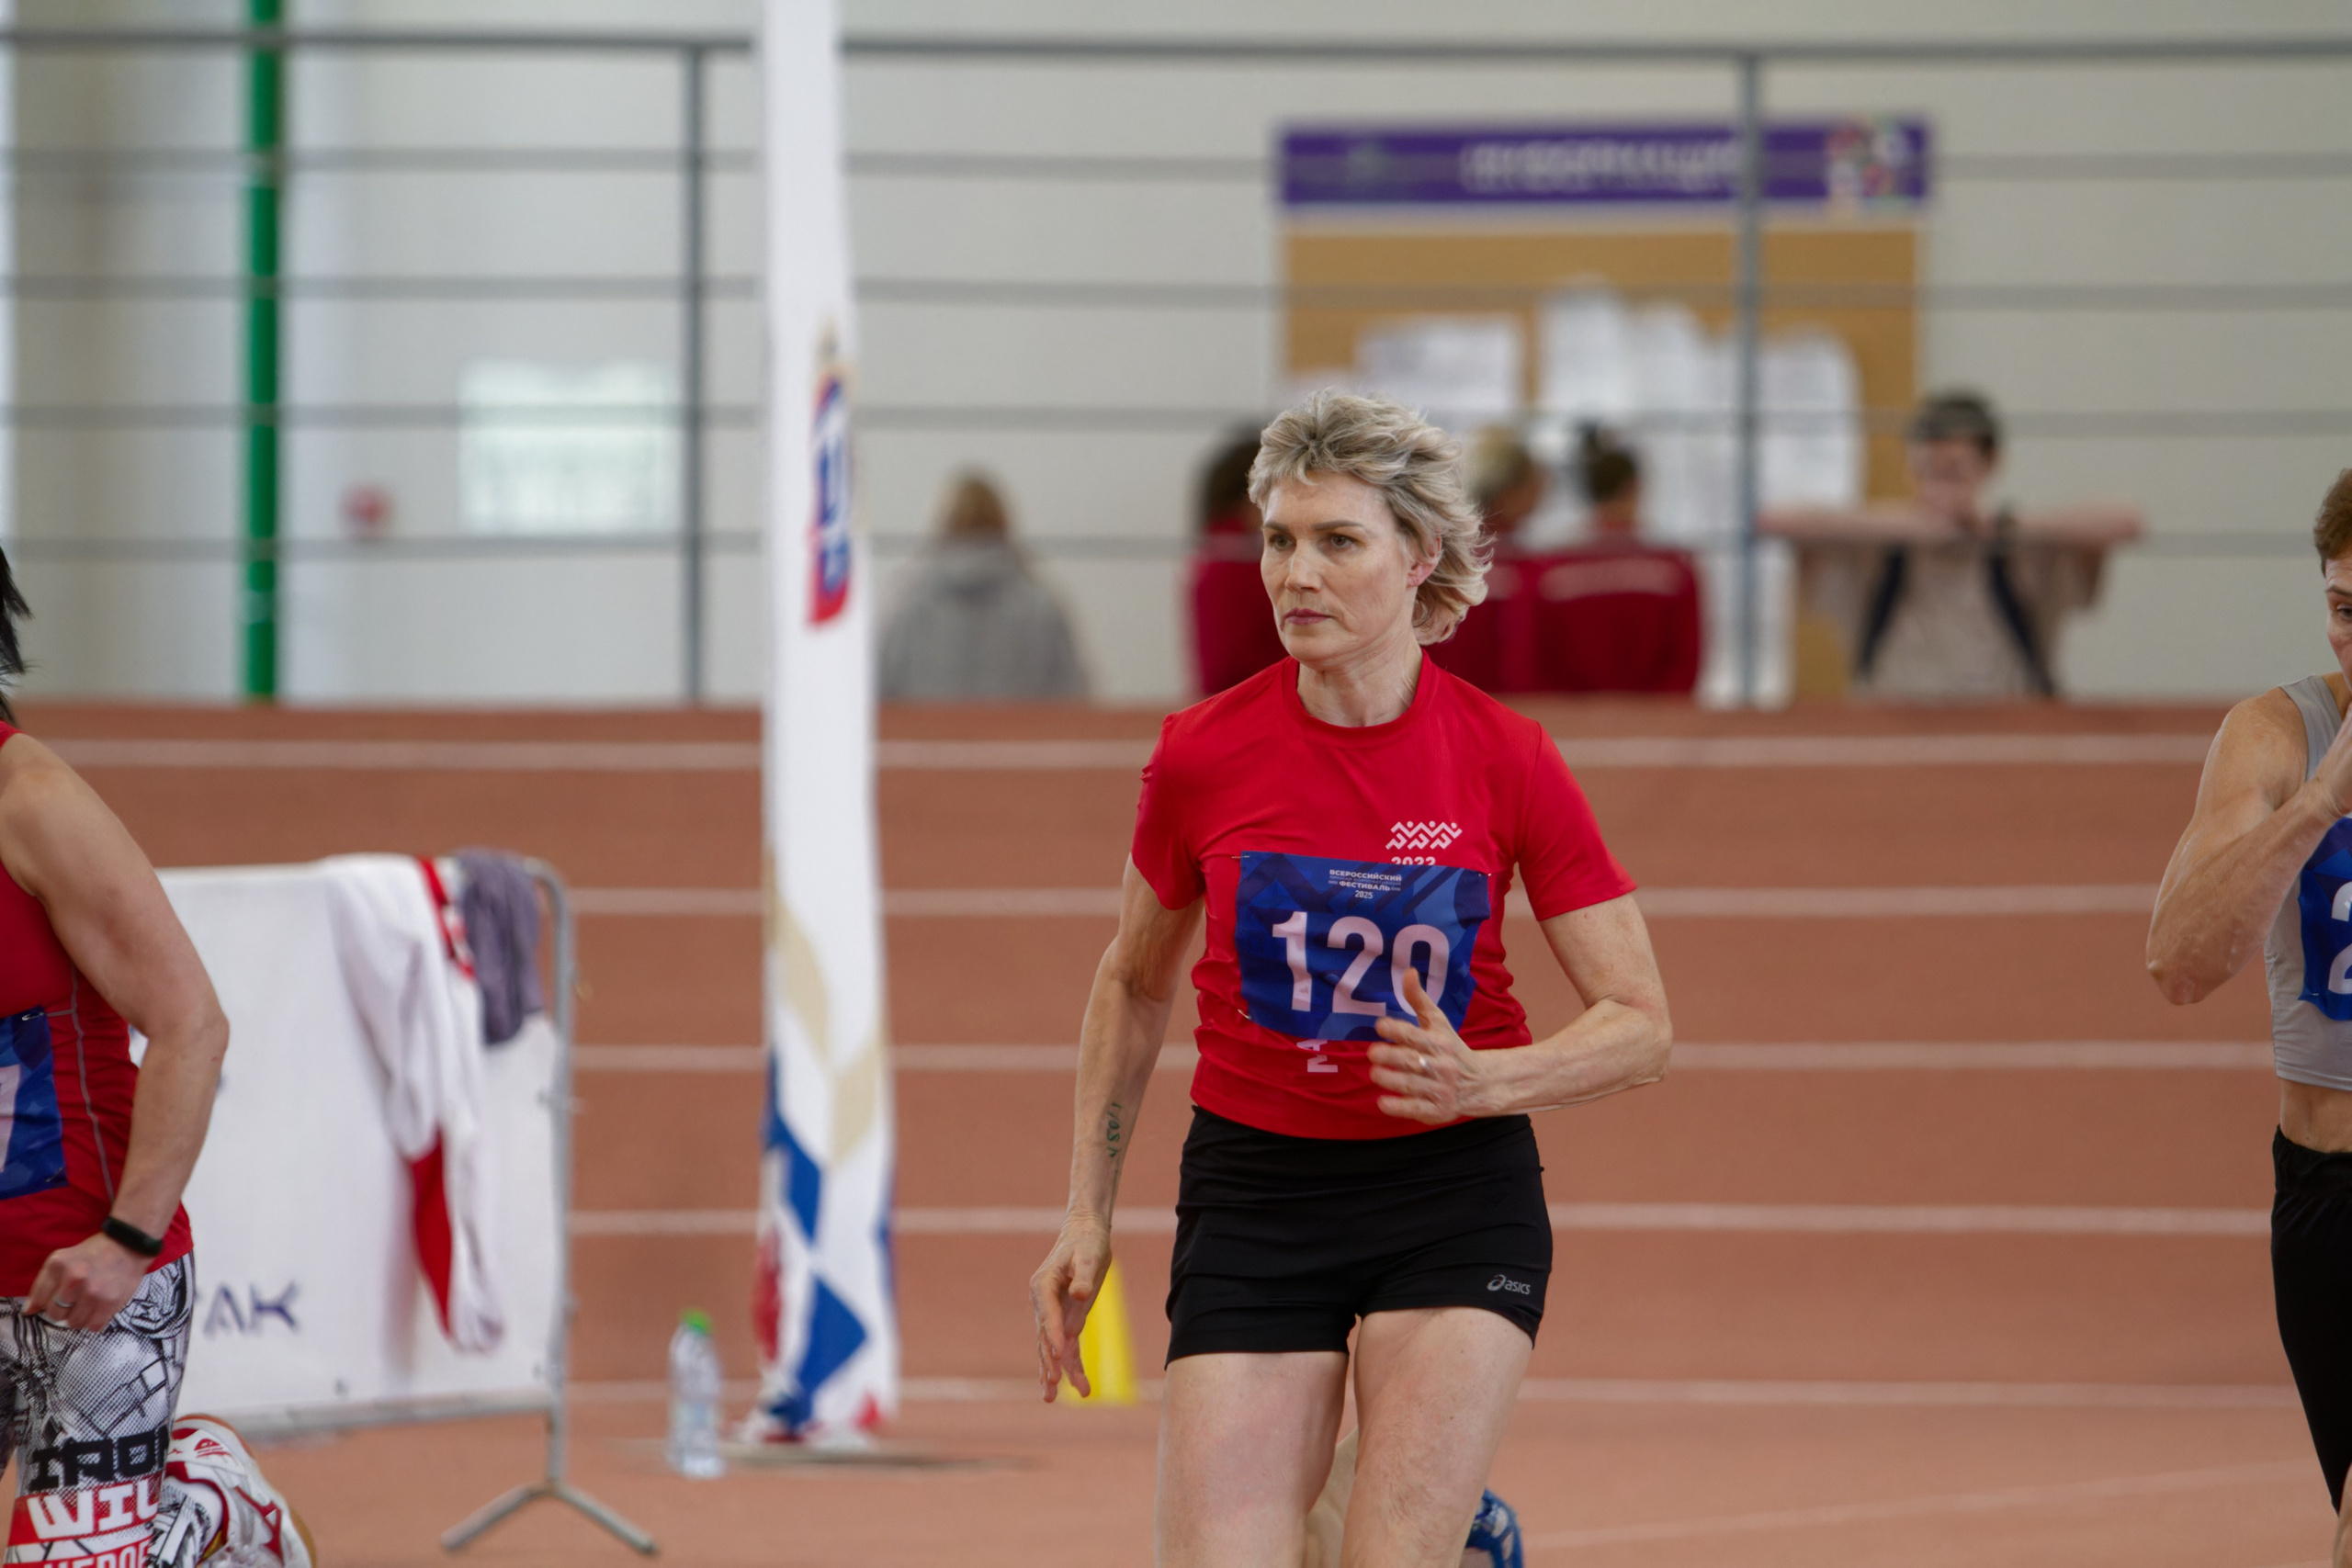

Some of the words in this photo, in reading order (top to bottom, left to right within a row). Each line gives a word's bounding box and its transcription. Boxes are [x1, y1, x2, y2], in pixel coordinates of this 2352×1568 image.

[1329, 869, 1402, 882] ВСЕРОССИЙСКИЙ
[1339, 880, 1390, 891] ФЕСТИВАЛЬ
[1354, 890, 1374, 899] 2025
[1272, 911, 1450, 1018] 120
